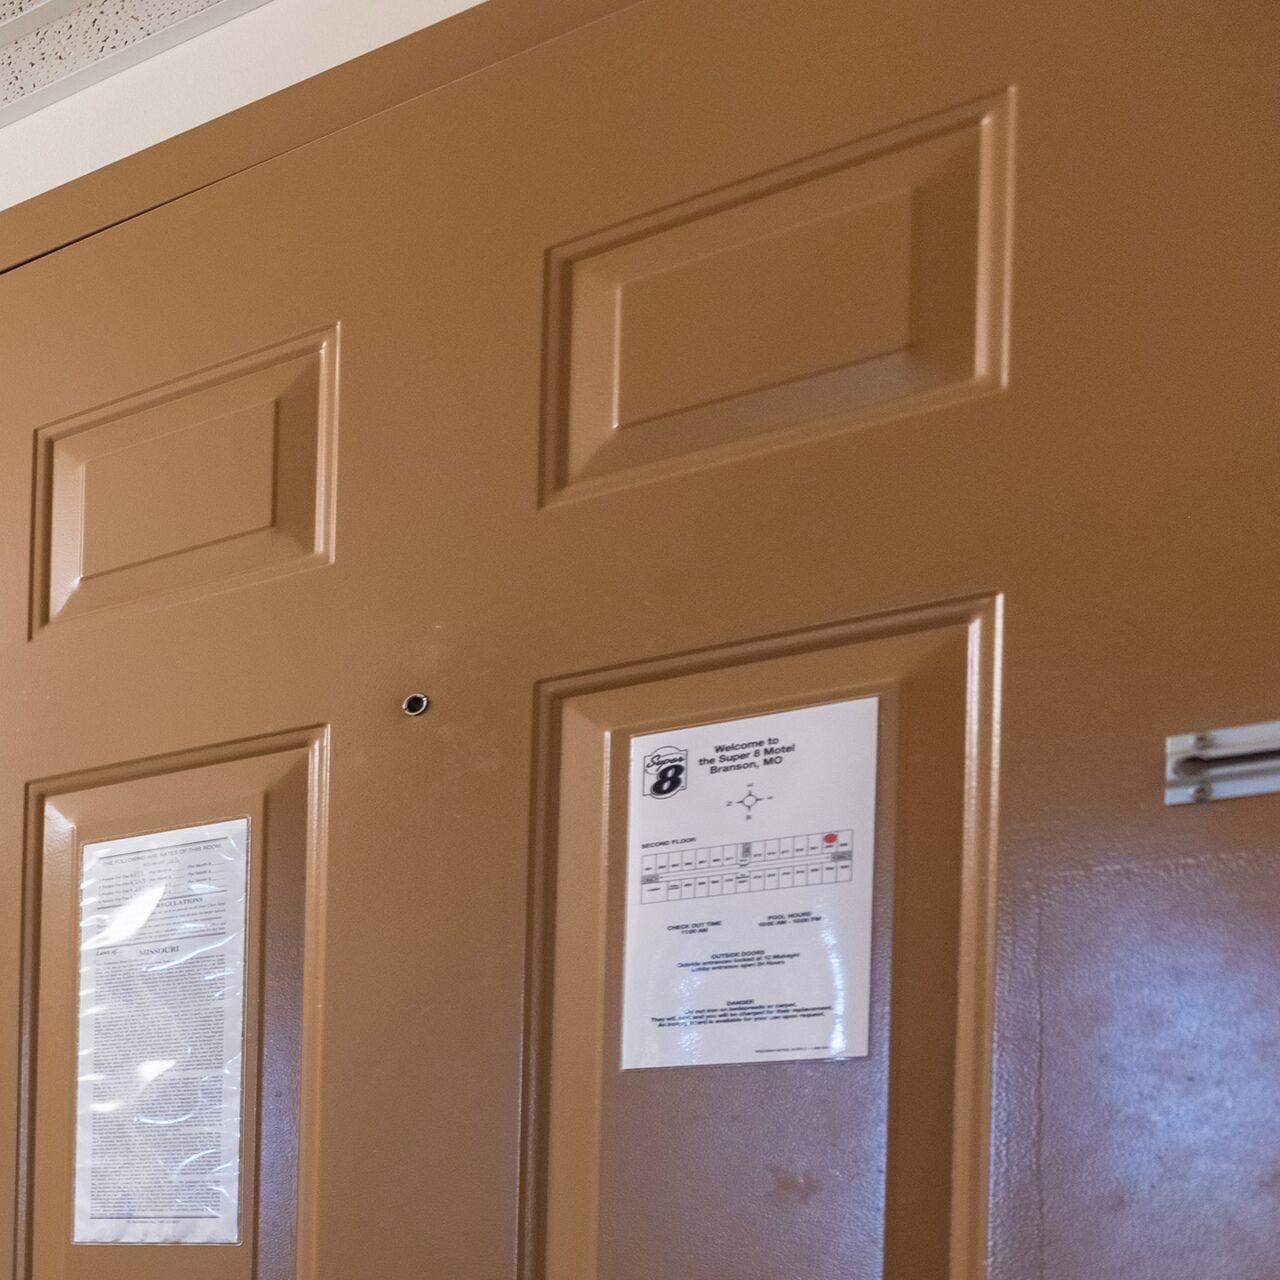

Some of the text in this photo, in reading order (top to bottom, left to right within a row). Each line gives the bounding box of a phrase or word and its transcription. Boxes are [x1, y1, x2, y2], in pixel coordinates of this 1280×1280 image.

[715, 737, 779, 753] Welcome to
[647, 754, 686, 772] Super
[699, 744, 795, 766] the Super 8 Motel
[710, 756, 783, 774] Branson, MO
[651, 764, 685, 795] 8
[641, 840, 670, 849] SECOND
